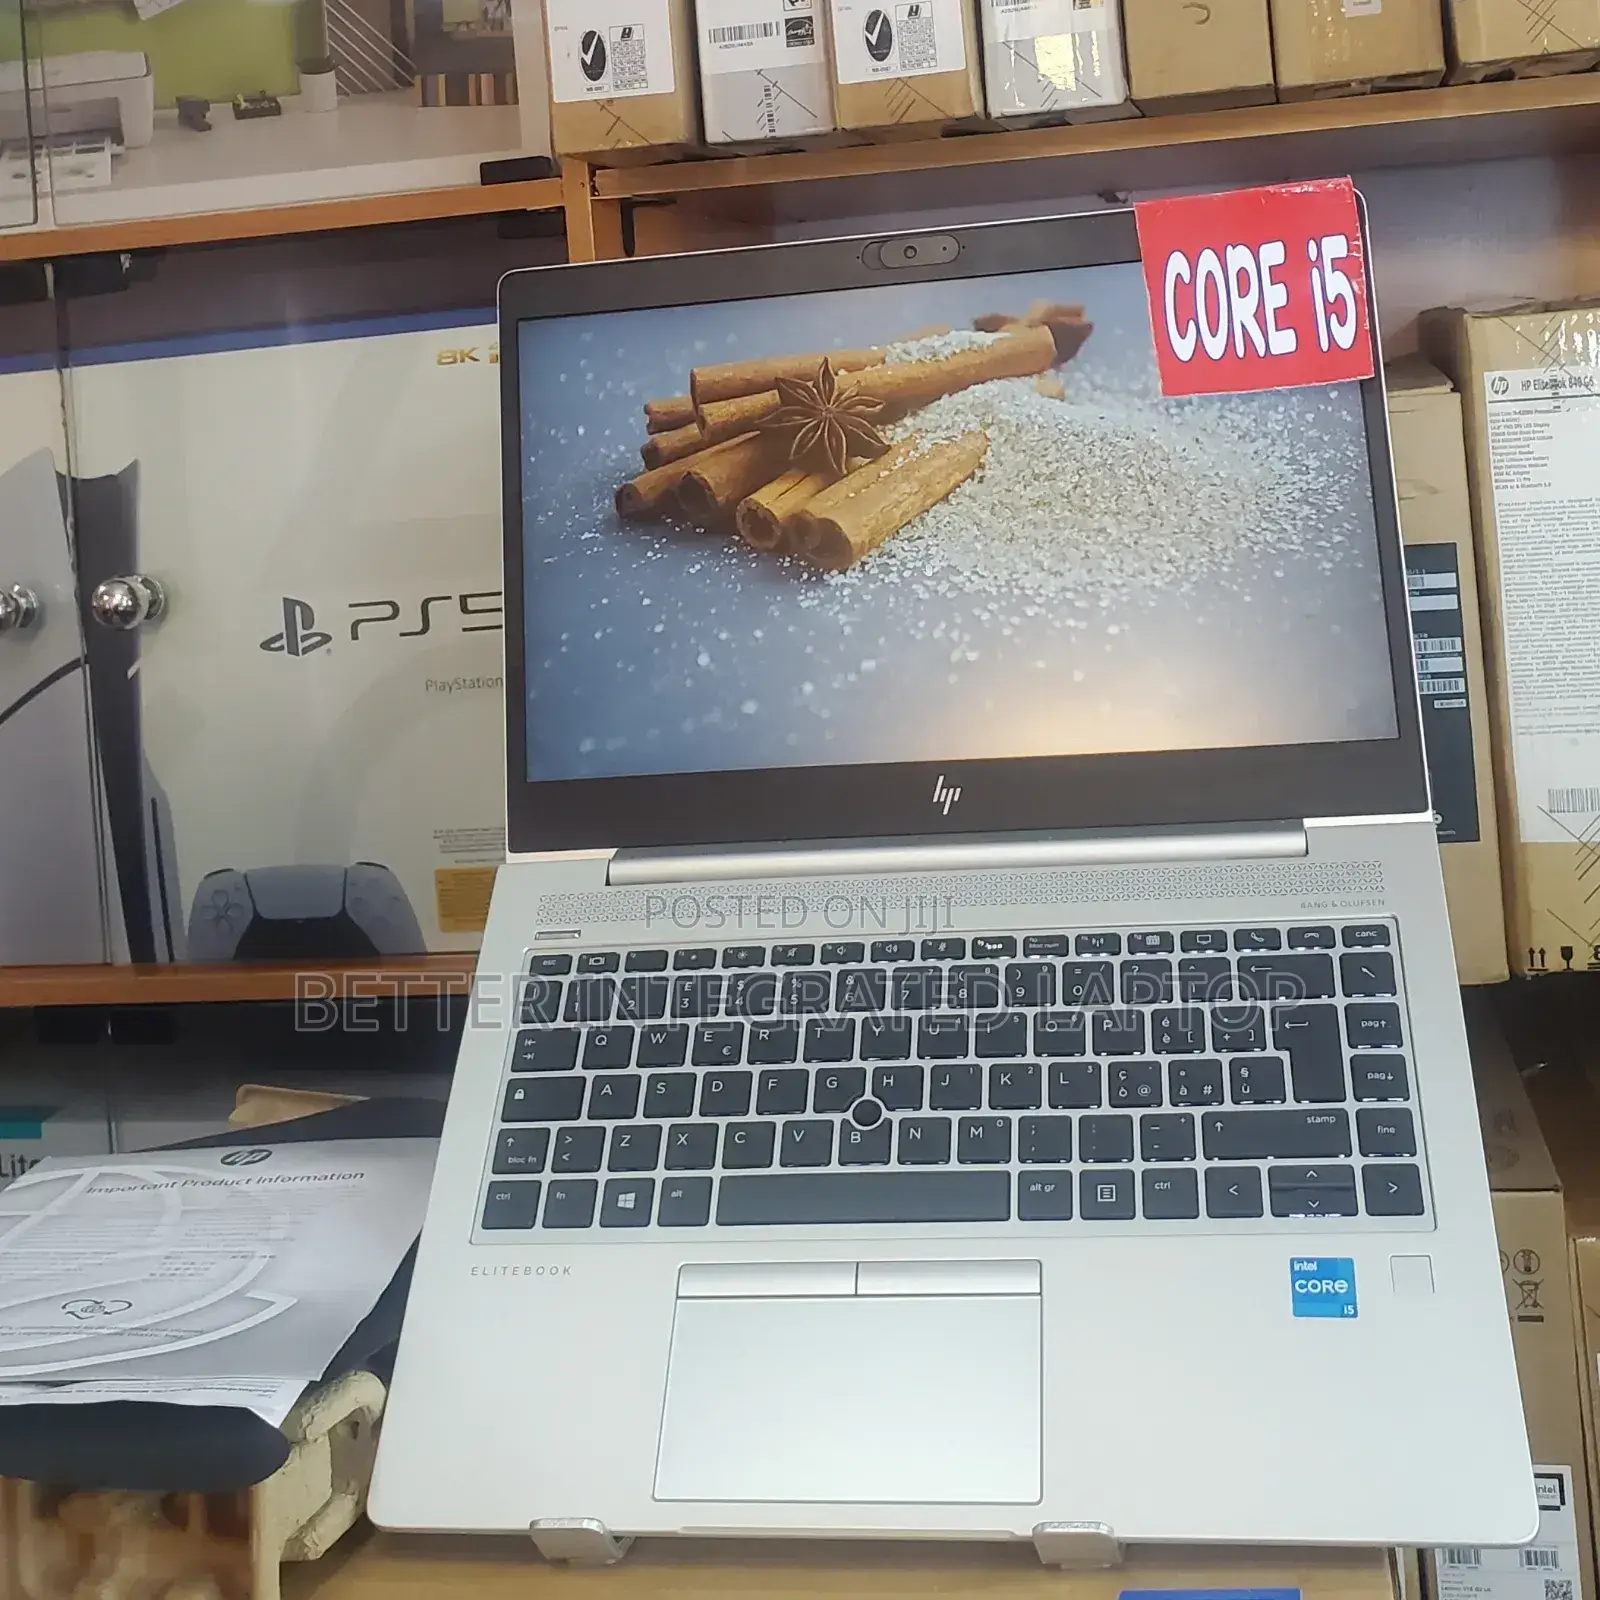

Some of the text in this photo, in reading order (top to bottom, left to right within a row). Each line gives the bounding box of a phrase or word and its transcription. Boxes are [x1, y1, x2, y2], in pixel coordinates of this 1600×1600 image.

[1164, 234, 1358, 363] CORE i5
[437, 347, 480, 365] 8K
[1491, 376, 1509, 396] hp
[1521, 379, 1532, 392] HP
[349, 591, 502, 641] PS5
[425, 677, 503, 694] PlayStation
[932, 775, 961, 815] hp
[1340, 899, 1385, 907] OLUFSEN
[542, 958, 556, 966] esc
[902, 991, 910, 1001] 7
[958, 988, 967, 998] 8
[1016, 987, 1025, 997] 9
[680, 998, 689, 1008] 3
[790, 994, 798, 1004] 5
[872, 1025, 882, 1036] Y
[929, 1025, 940, 1035] U
[1103, 1020, 1113, 1031] P
[650, 1032, 667, 1044] W
[704, 1031, 714, 1042] E
[759, 1030, 770, 1040] R
[814, 1027, 824, 1038] T
[595, 1034, 608, 1046] Q
[722, 1046, 731, 1055] €
[826, 1077, 838, 1088] G
[883, 1075, 894, 1087] H
[940, 1074, 950, 1086] J
[1000, 1073, 1011, 1085] K
[1060, 1072, 1069, 1084] L
[600, 1084, 613, 1095] A
[656, 1082, 666, 1093] S
[711, 1081, 723, 1092] D
[768, 1079, 778, 1090] F
[1137, 1085, 1151, 1095] @
[1203, 1085, 1212, 1095] #
[1306, 1116, 1336, 1124] stamp
[909, 1128, 921, 1139] N
[970, 1126, 983, 1138] M
[1377, 1126, 1395, 1134] fine
[620, 1135, 631, 1147] Z
[676, 1133, 689, 1145] X
[734, 1132, 746, 1144] C
[793, 1130, 804, 1142] V
[850, 1132, 861, 1143] B
[507, 1155, 537, 1164] bloc fn
[0, 1153, 44, 1178] Lit
[85, 1171, 366, 1194] Important Product Information
[1030, 1183, 1055, 1192] alt gr
[1155, 1181, 1171, 1190] ctrl
[496, 1192, 511, 1200] ctrl
[671, 1189, 683, 1198] alt
[471, 1265, 572, 1276] ELITEBOOK
[1294, 1260, 1317, 1271] intel
